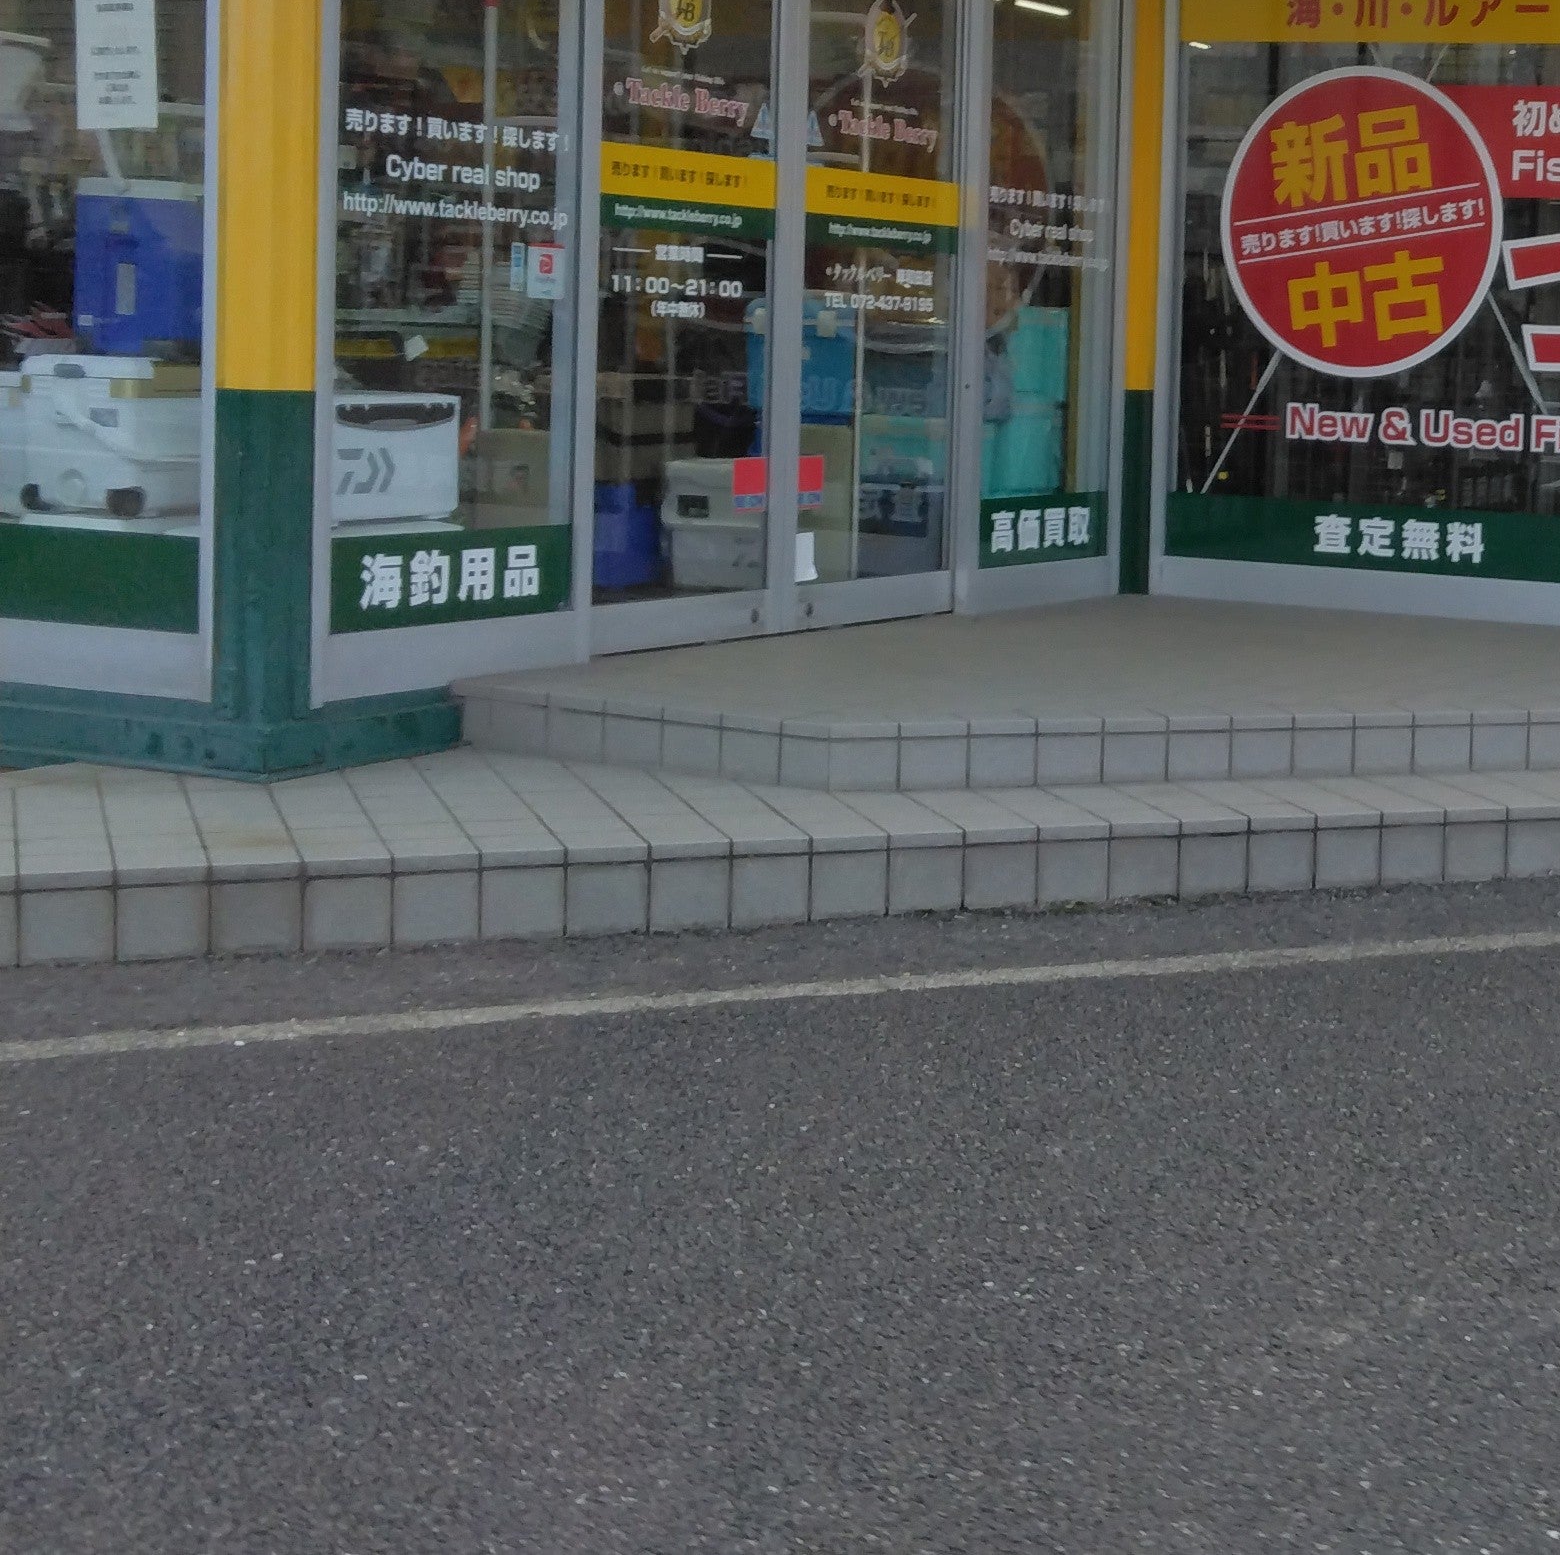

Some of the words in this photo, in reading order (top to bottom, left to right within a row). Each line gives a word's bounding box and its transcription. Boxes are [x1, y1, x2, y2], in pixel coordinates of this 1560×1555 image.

[625, 76, 691, 112] Tackle
[694, 87, 750, 128] Berry
[385, 153, 447, 183] Cyber
[451, 163, 490, 186] real
[494, 165, 541, 193] shop
[1269, 104, 1433, 209] 新品
[342, 190, 569, 230] http://www.tackleberry.co.jp
[1286, 249, 1445, 349] 中古
[1284, 400, 1376, 445] New
[1378, 407, 1416, 445] &
[1420, 409, 1523, 454] Used
[990, 505, 1092, 554] 高価買取
[1313, 512, 1486, 565] 査定無料
[359, 544, 541, 611] 海釣用品
